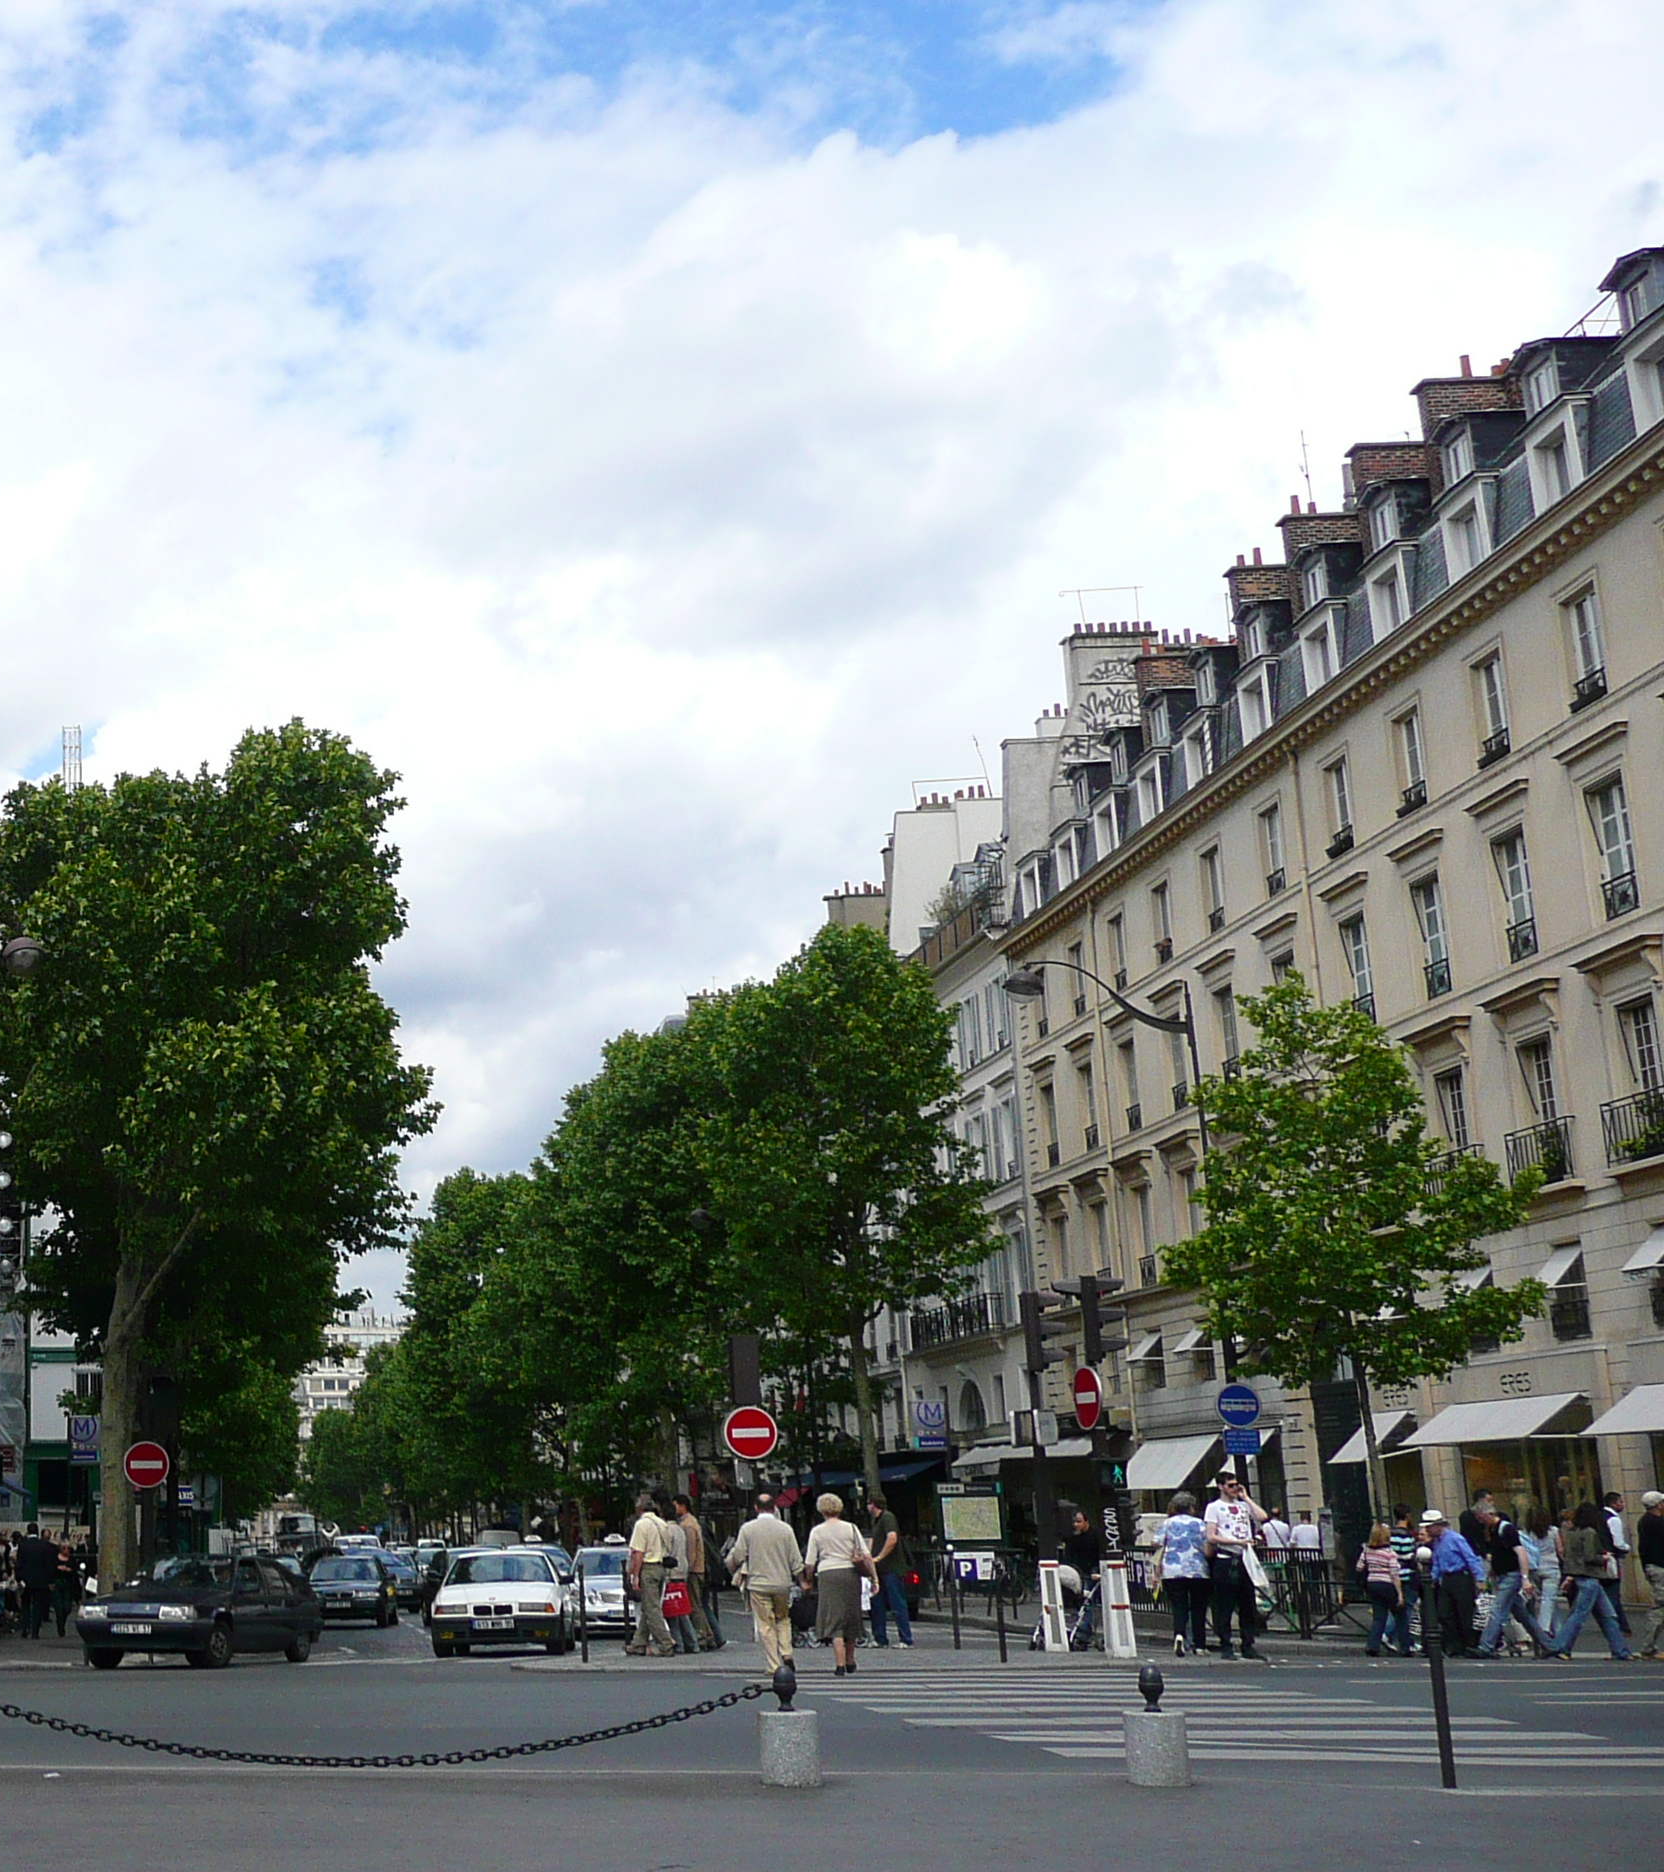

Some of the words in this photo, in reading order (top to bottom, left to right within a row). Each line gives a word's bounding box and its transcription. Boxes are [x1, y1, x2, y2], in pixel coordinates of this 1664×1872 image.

[1499, 1371, 1532, 1395] ERES
[924, 1403, 942, 1420] M
[74, 1419, 90, 1436] M
[959, 1561, 973, 1578] P
